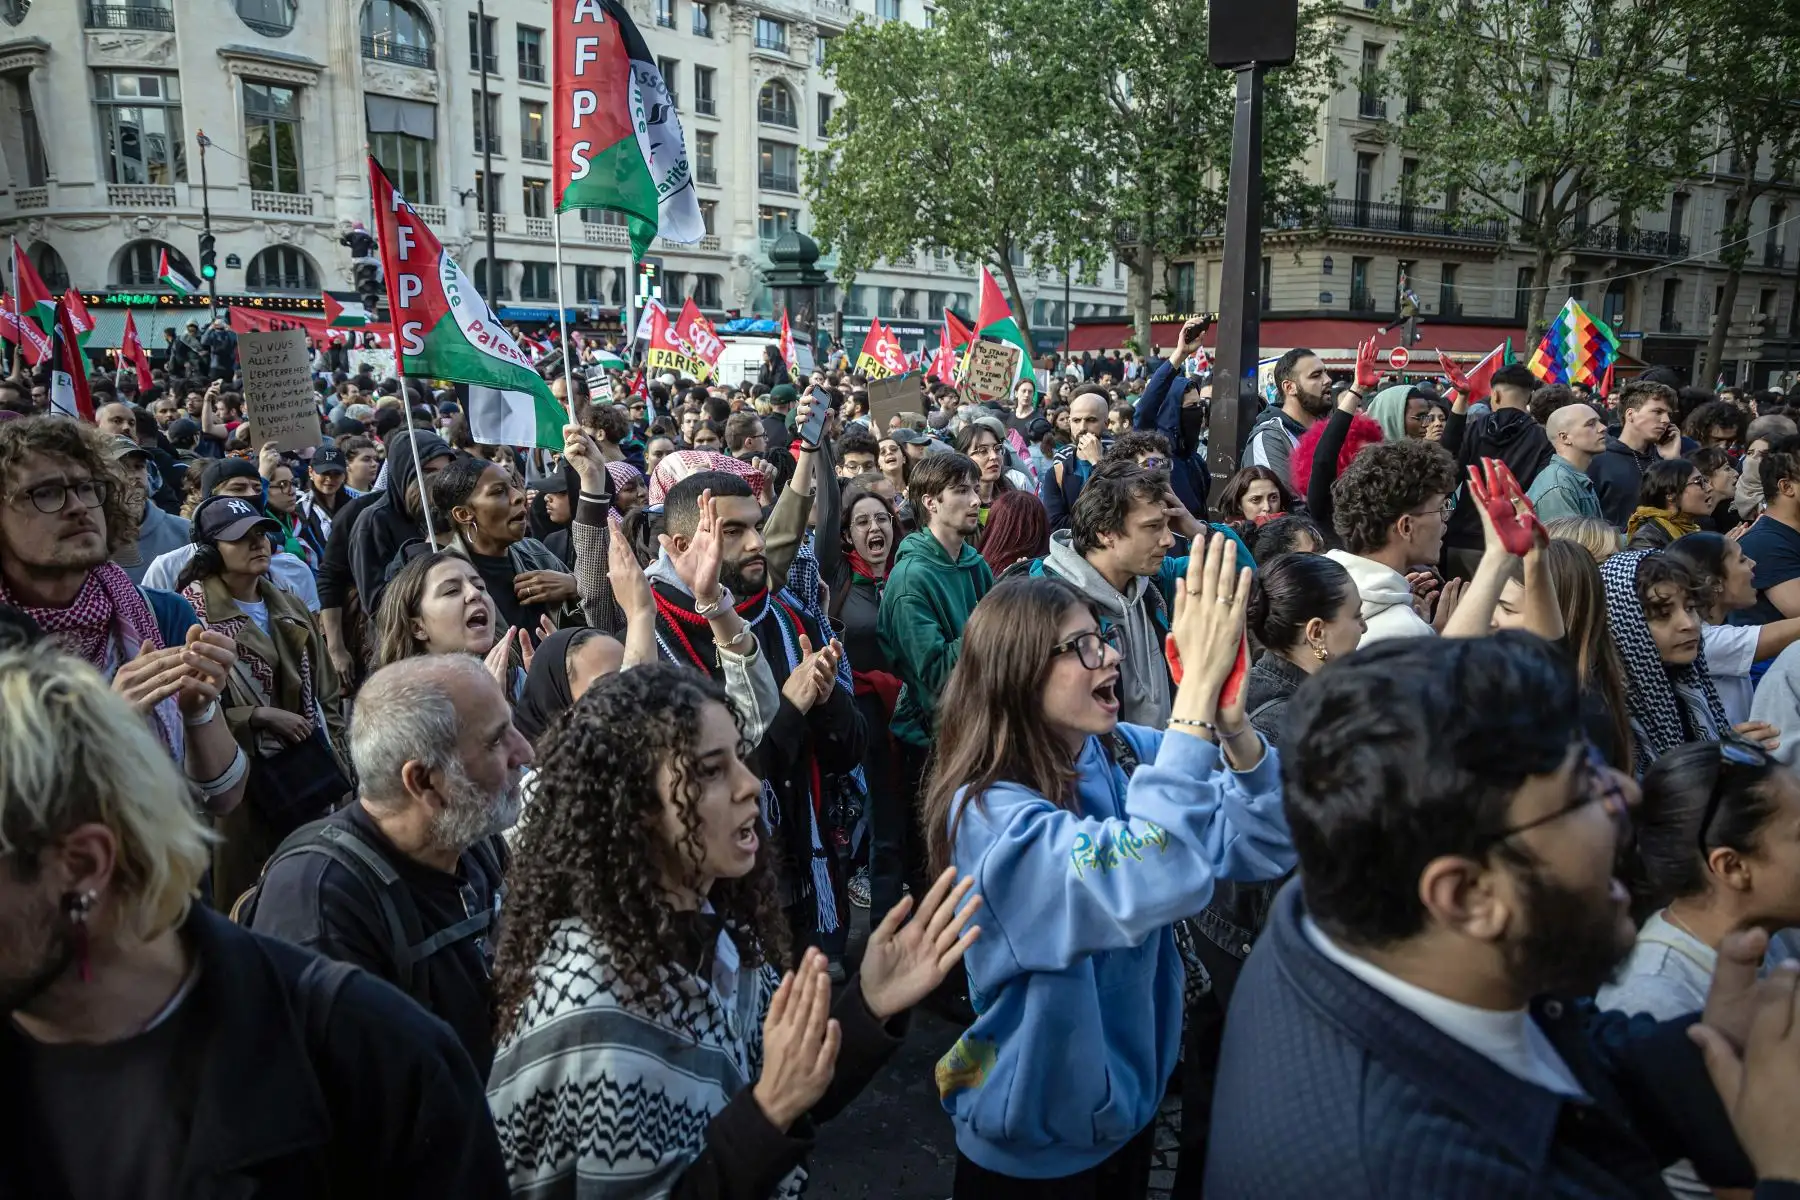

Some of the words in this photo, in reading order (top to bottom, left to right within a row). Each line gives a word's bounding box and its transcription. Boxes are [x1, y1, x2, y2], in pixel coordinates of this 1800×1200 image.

[249, 340, 263, 355] SI
[657, 350, 700, 375] PARIS
[325, 451, 337, 461] F
[227, 500, 251, 514] NY
